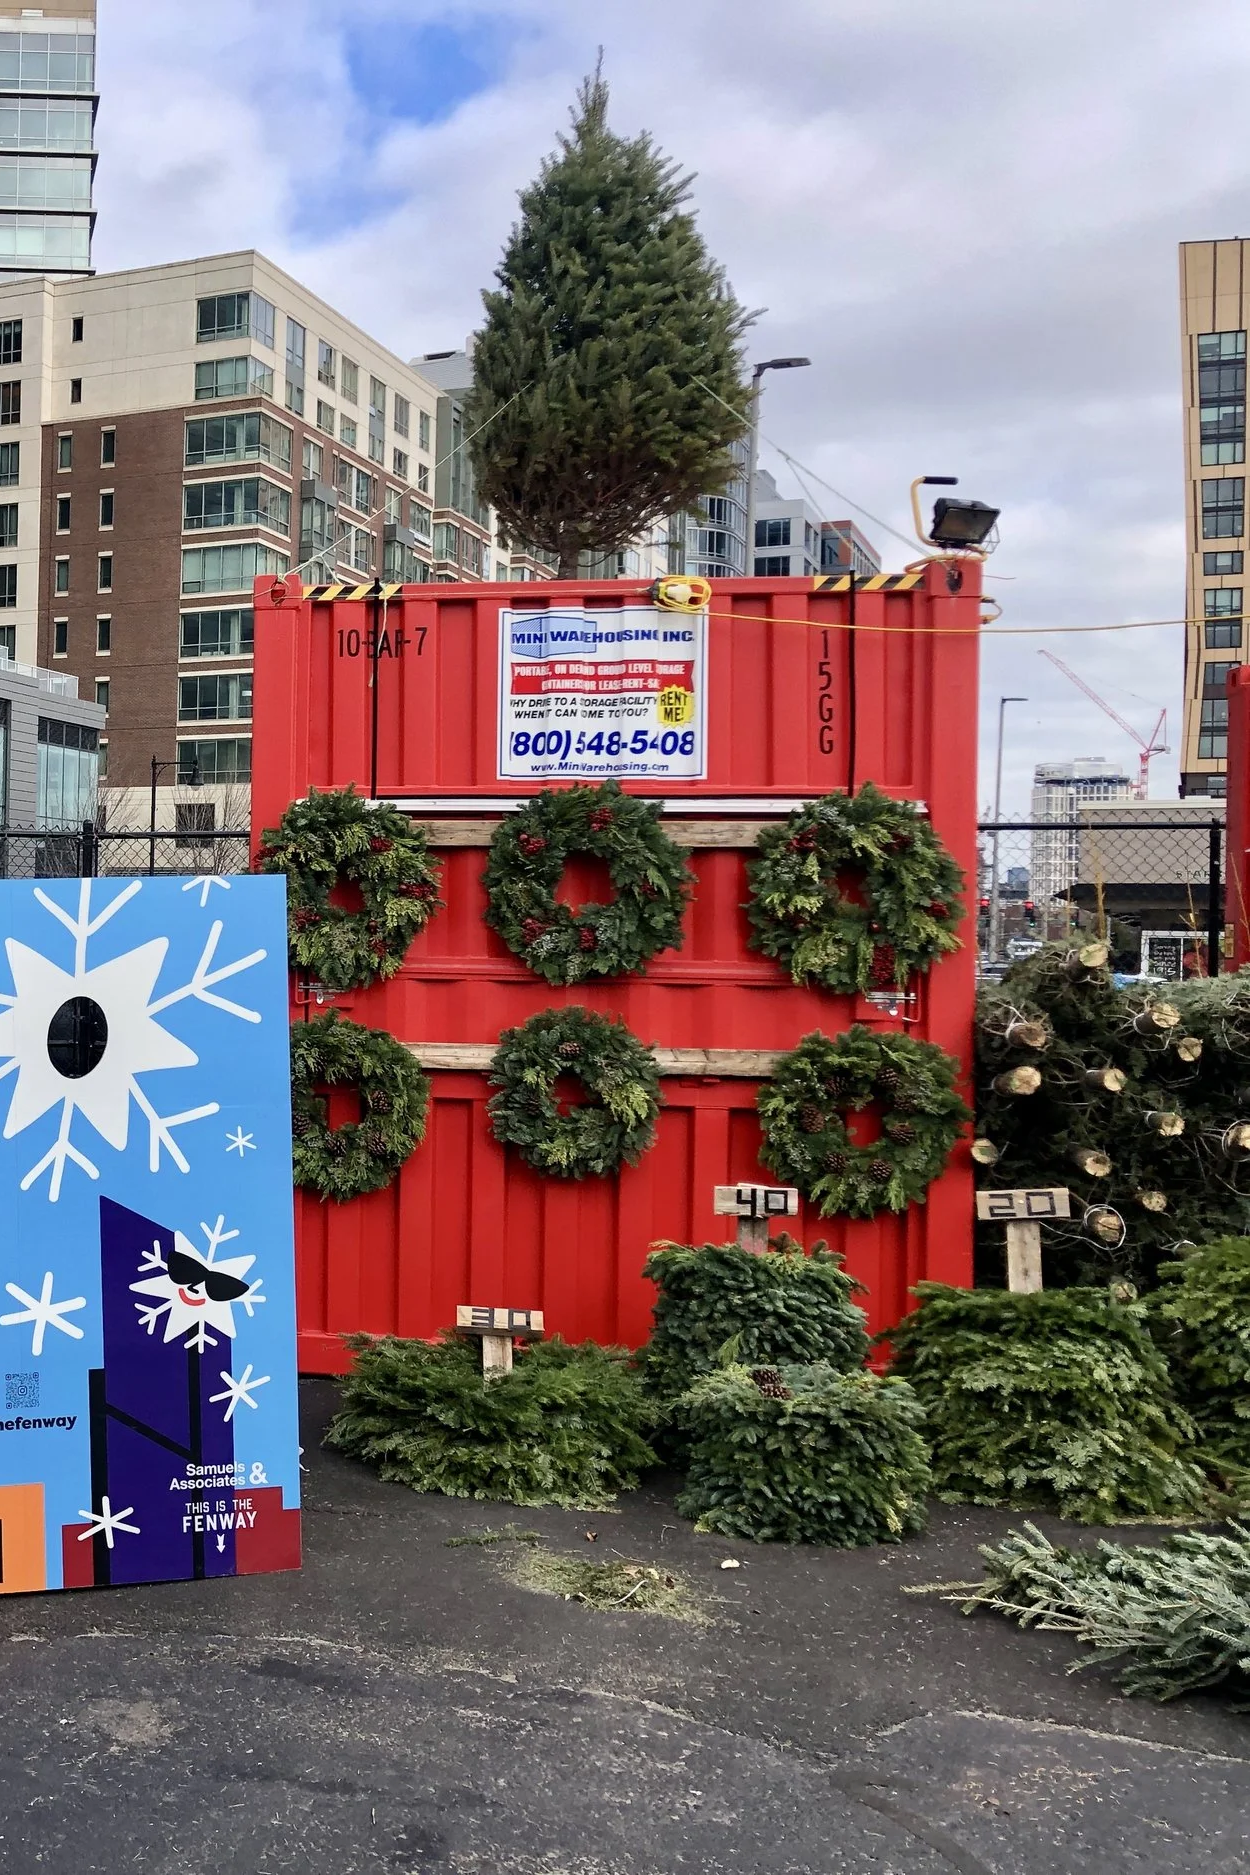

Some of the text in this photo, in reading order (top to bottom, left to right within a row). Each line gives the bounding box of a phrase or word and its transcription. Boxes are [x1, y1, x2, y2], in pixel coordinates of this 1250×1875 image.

[662, 630, 695, 642] INC.
[628, 662, 654, 674] LEVEL
[555, 697, 567, 706] TO
[570, 697, 577, 706] A
[660, 691, 688, 707] RENT
[514, 710, 545, 719] WHEN
[555, 709, 577, 718] CAN
[621, 708, 648, 718] YOU?
[664, 707, 684, 722] ME!
[509, 730, 572, 761] (800)
[736, 1188, 788, 1217] 40
[988, 1192, 1056, 1217] 20
[471, 1308, 531, 1330] 30
[186, 1461, 268, 1485] Samuels &
[169, 1475, 246, 1490] Associates
[185, 1498, 253, 1514] THIS IS THE
[182, 1511, 257, 1533] FENWAY
